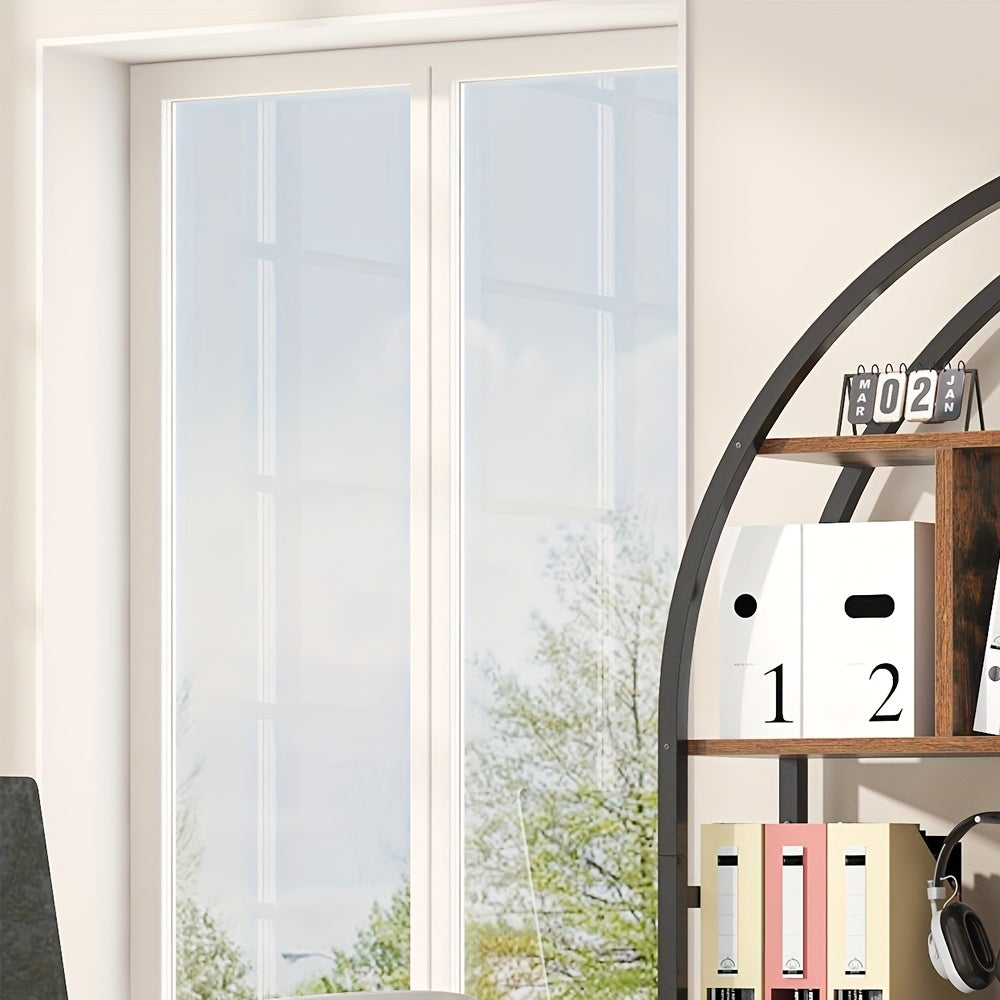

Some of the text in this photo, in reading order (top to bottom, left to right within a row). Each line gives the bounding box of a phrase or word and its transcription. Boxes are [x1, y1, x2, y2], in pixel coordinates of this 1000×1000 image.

[855, 379, 871, 416] MAR
[944, 375, 955, 412] JAN
[763, 663, 794, 723] 1
[868, 662, 904, 722] 2
